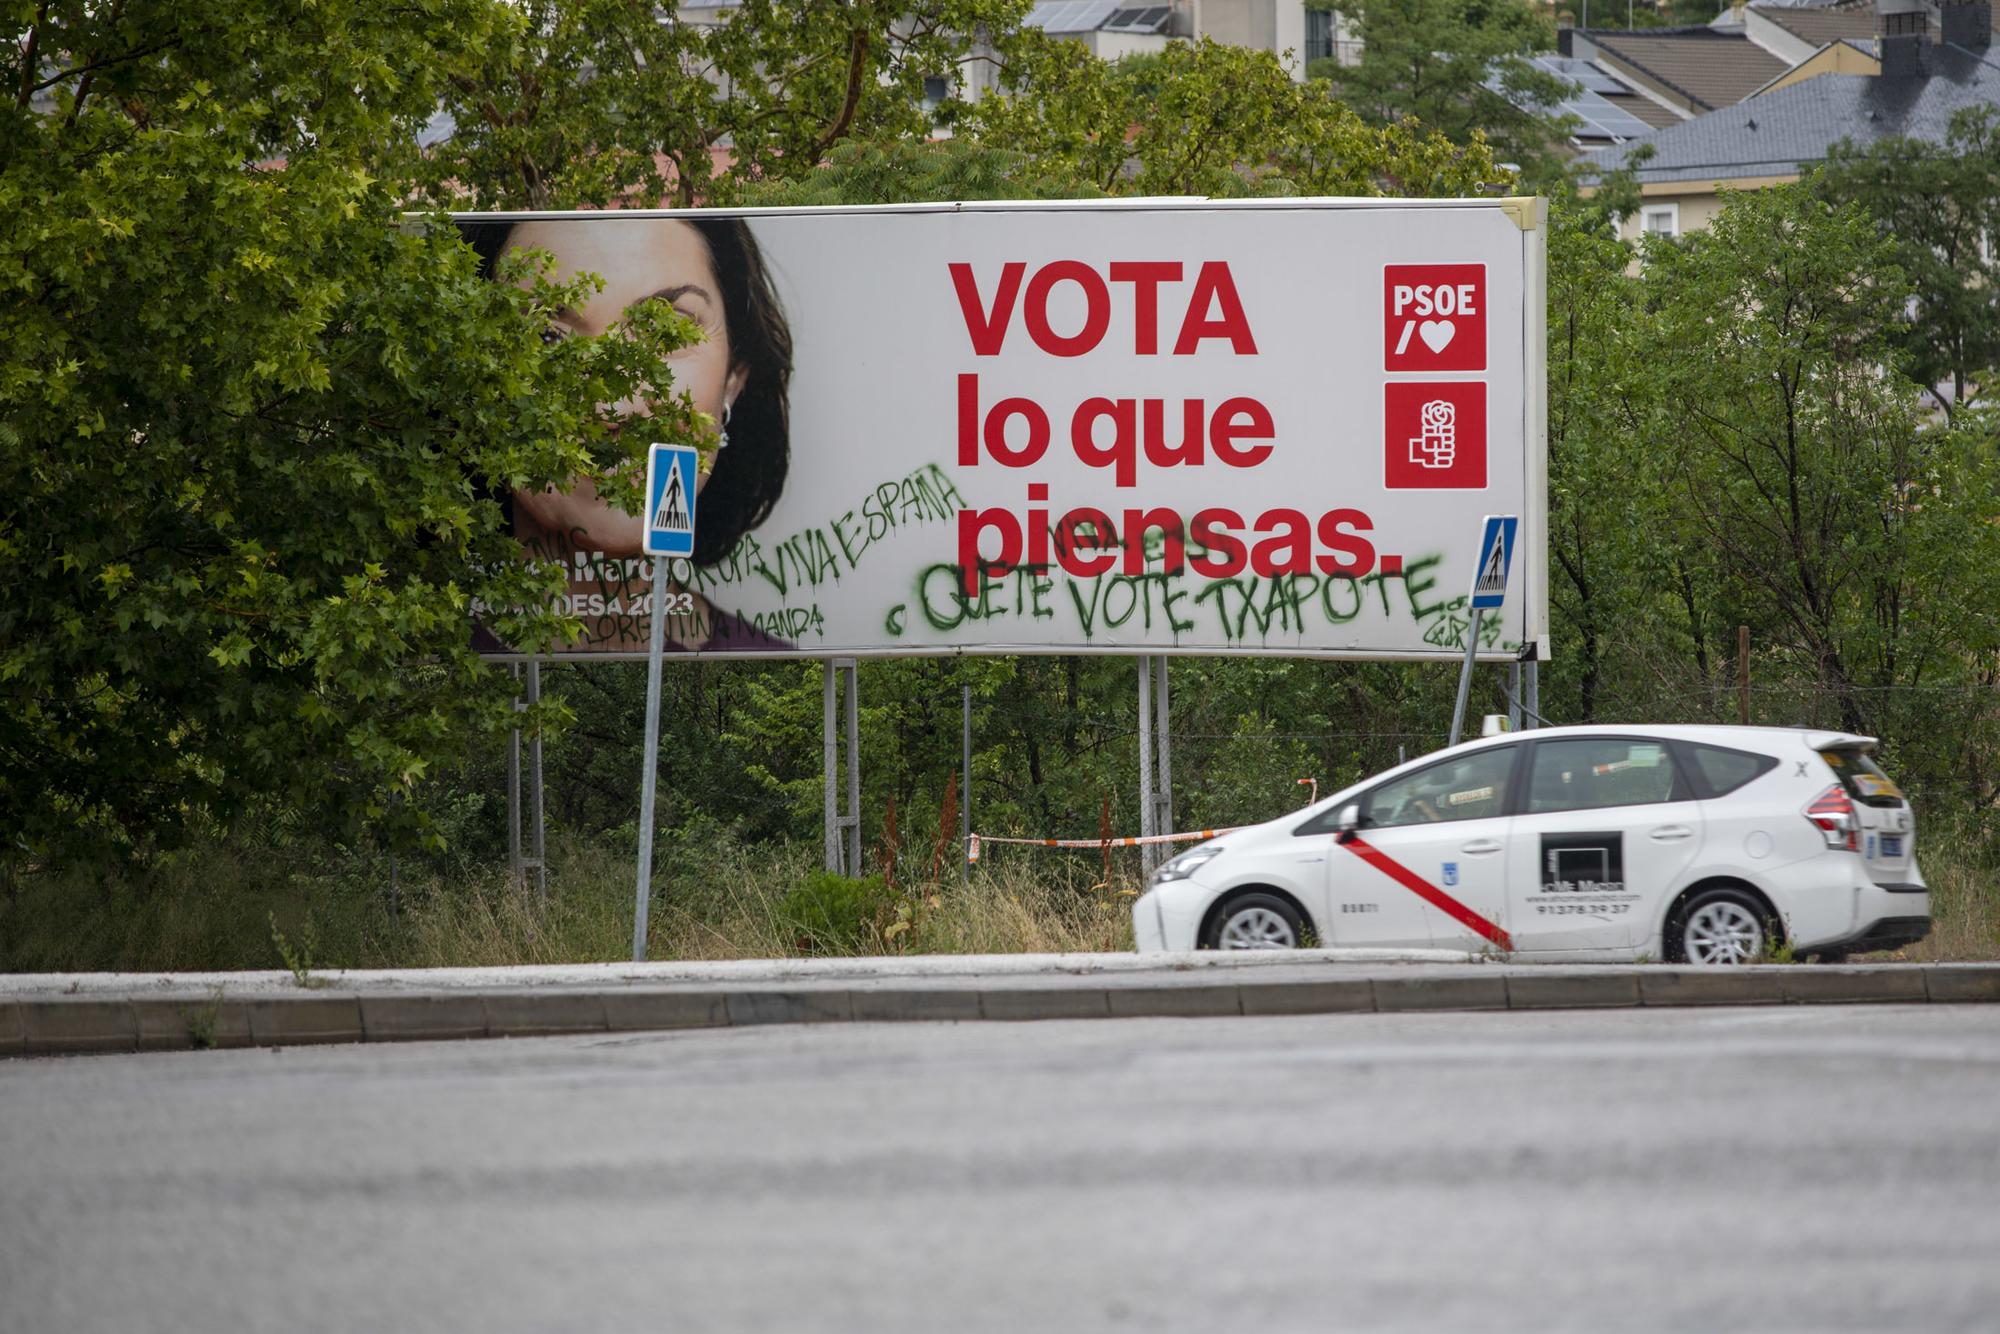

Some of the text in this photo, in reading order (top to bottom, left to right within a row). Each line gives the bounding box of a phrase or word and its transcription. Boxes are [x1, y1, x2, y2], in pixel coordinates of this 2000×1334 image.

[947, 260, 1259, 357] VOTA
[1394, 284, 1476, 316] PSOE
[958, 373, 1276, 487] lo que
[575, 551, 692, 582] Maroo
[957, 483, 1403, 597] piensas.
[918, 558, 1008, 631] QUE
[1068, 566, 1193, 637] VOTE
[1196, 555, 1444, 640] TXAPOTE
